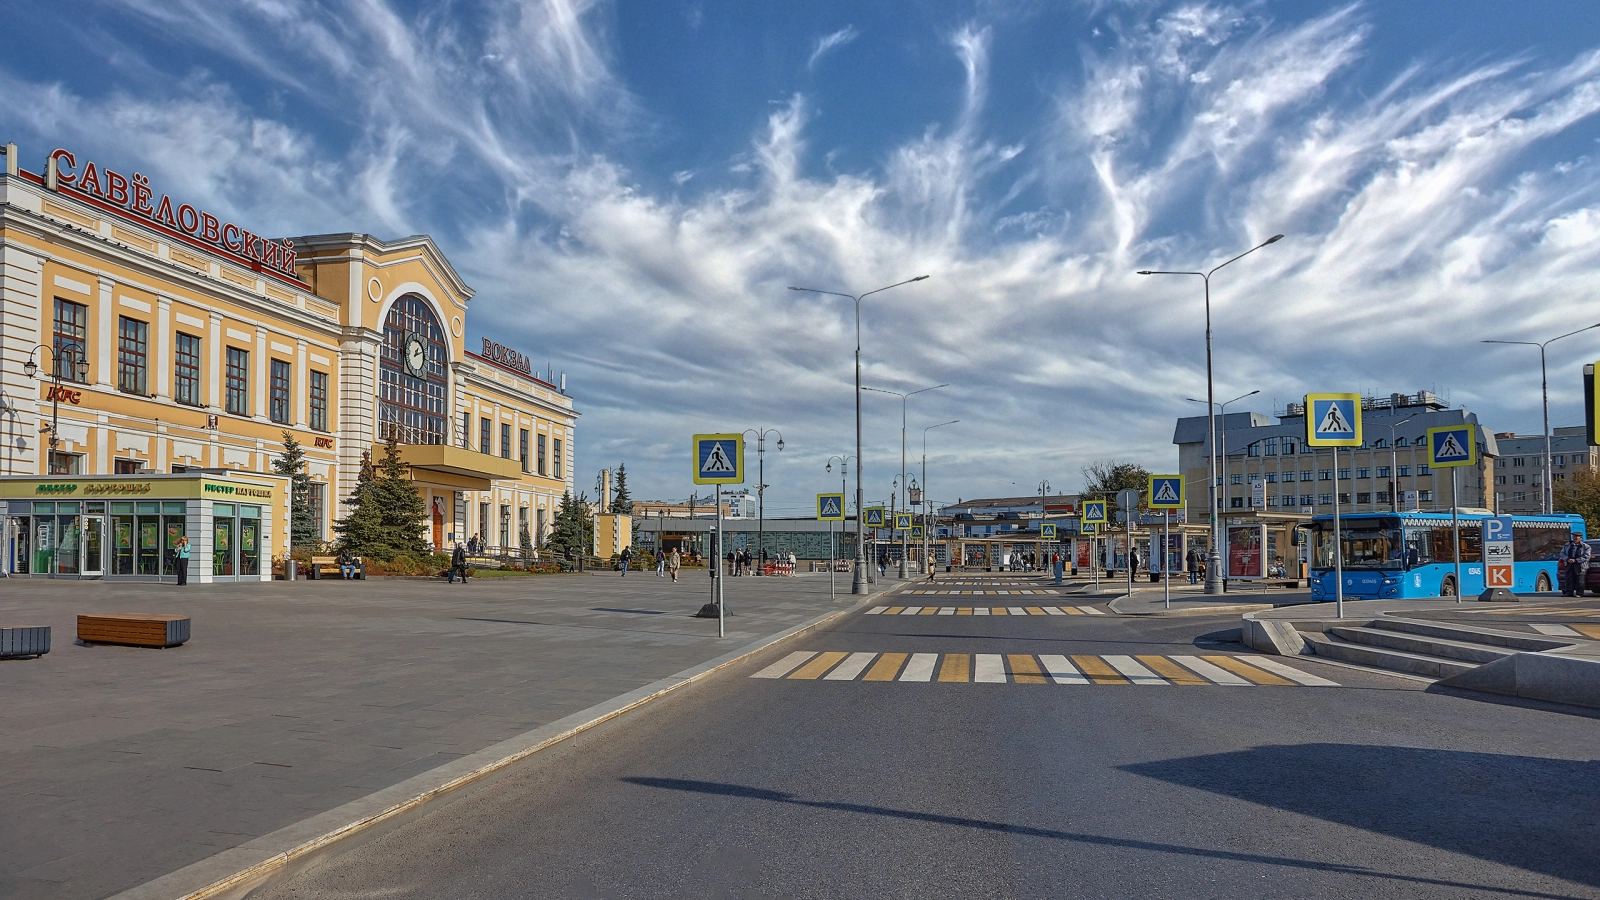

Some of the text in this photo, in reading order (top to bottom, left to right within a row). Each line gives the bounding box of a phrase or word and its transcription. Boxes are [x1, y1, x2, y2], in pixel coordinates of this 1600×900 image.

[51, 148, 298, 277] САВЁЛОВСКИЙ
[482, 337, 531, 374] ВОКЗАЛ
[46, 386, 81, 405] KFC
[314, 436, 333, 449] KFC
[38, 483, 151, 492] МИСТЕР КАРТОШКА
[204, 483, 272, 499] МИСТЕР КАРТОШКА
[1487, 519, 1503, 539] P
[1492, 568, 1508, 584] K
